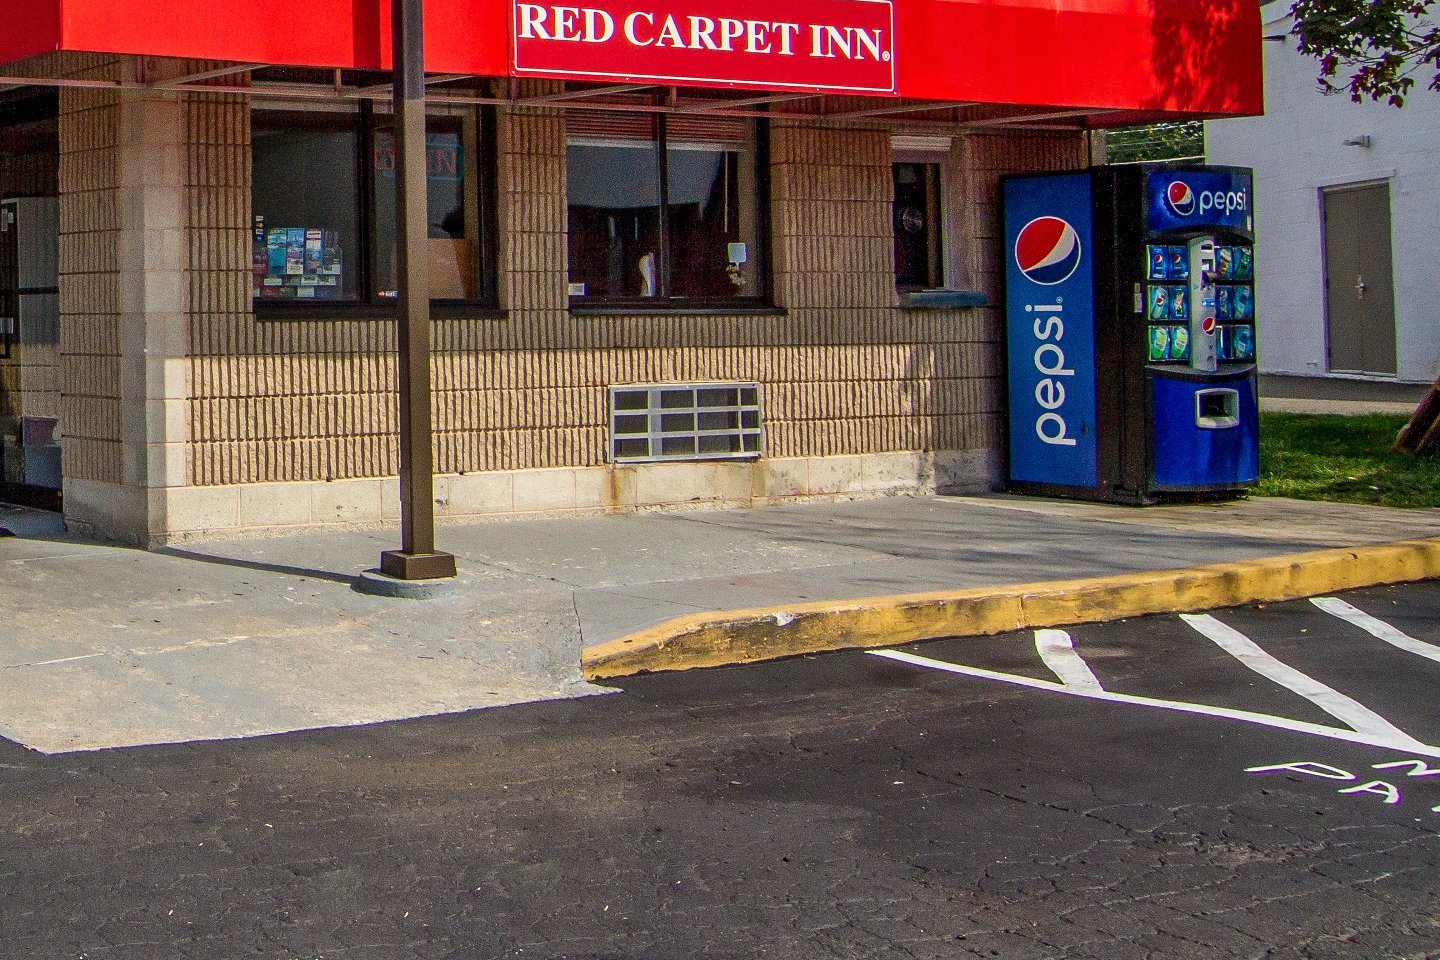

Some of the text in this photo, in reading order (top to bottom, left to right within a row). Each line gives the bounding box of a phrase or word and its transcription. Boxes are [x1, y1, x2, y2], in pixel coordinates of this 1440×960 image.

[517, 3, 883, 62] RED CARPET INN
[1199, 187, 1247, 216] pepsi
[1024, 304, 1077, 446] pepsi
